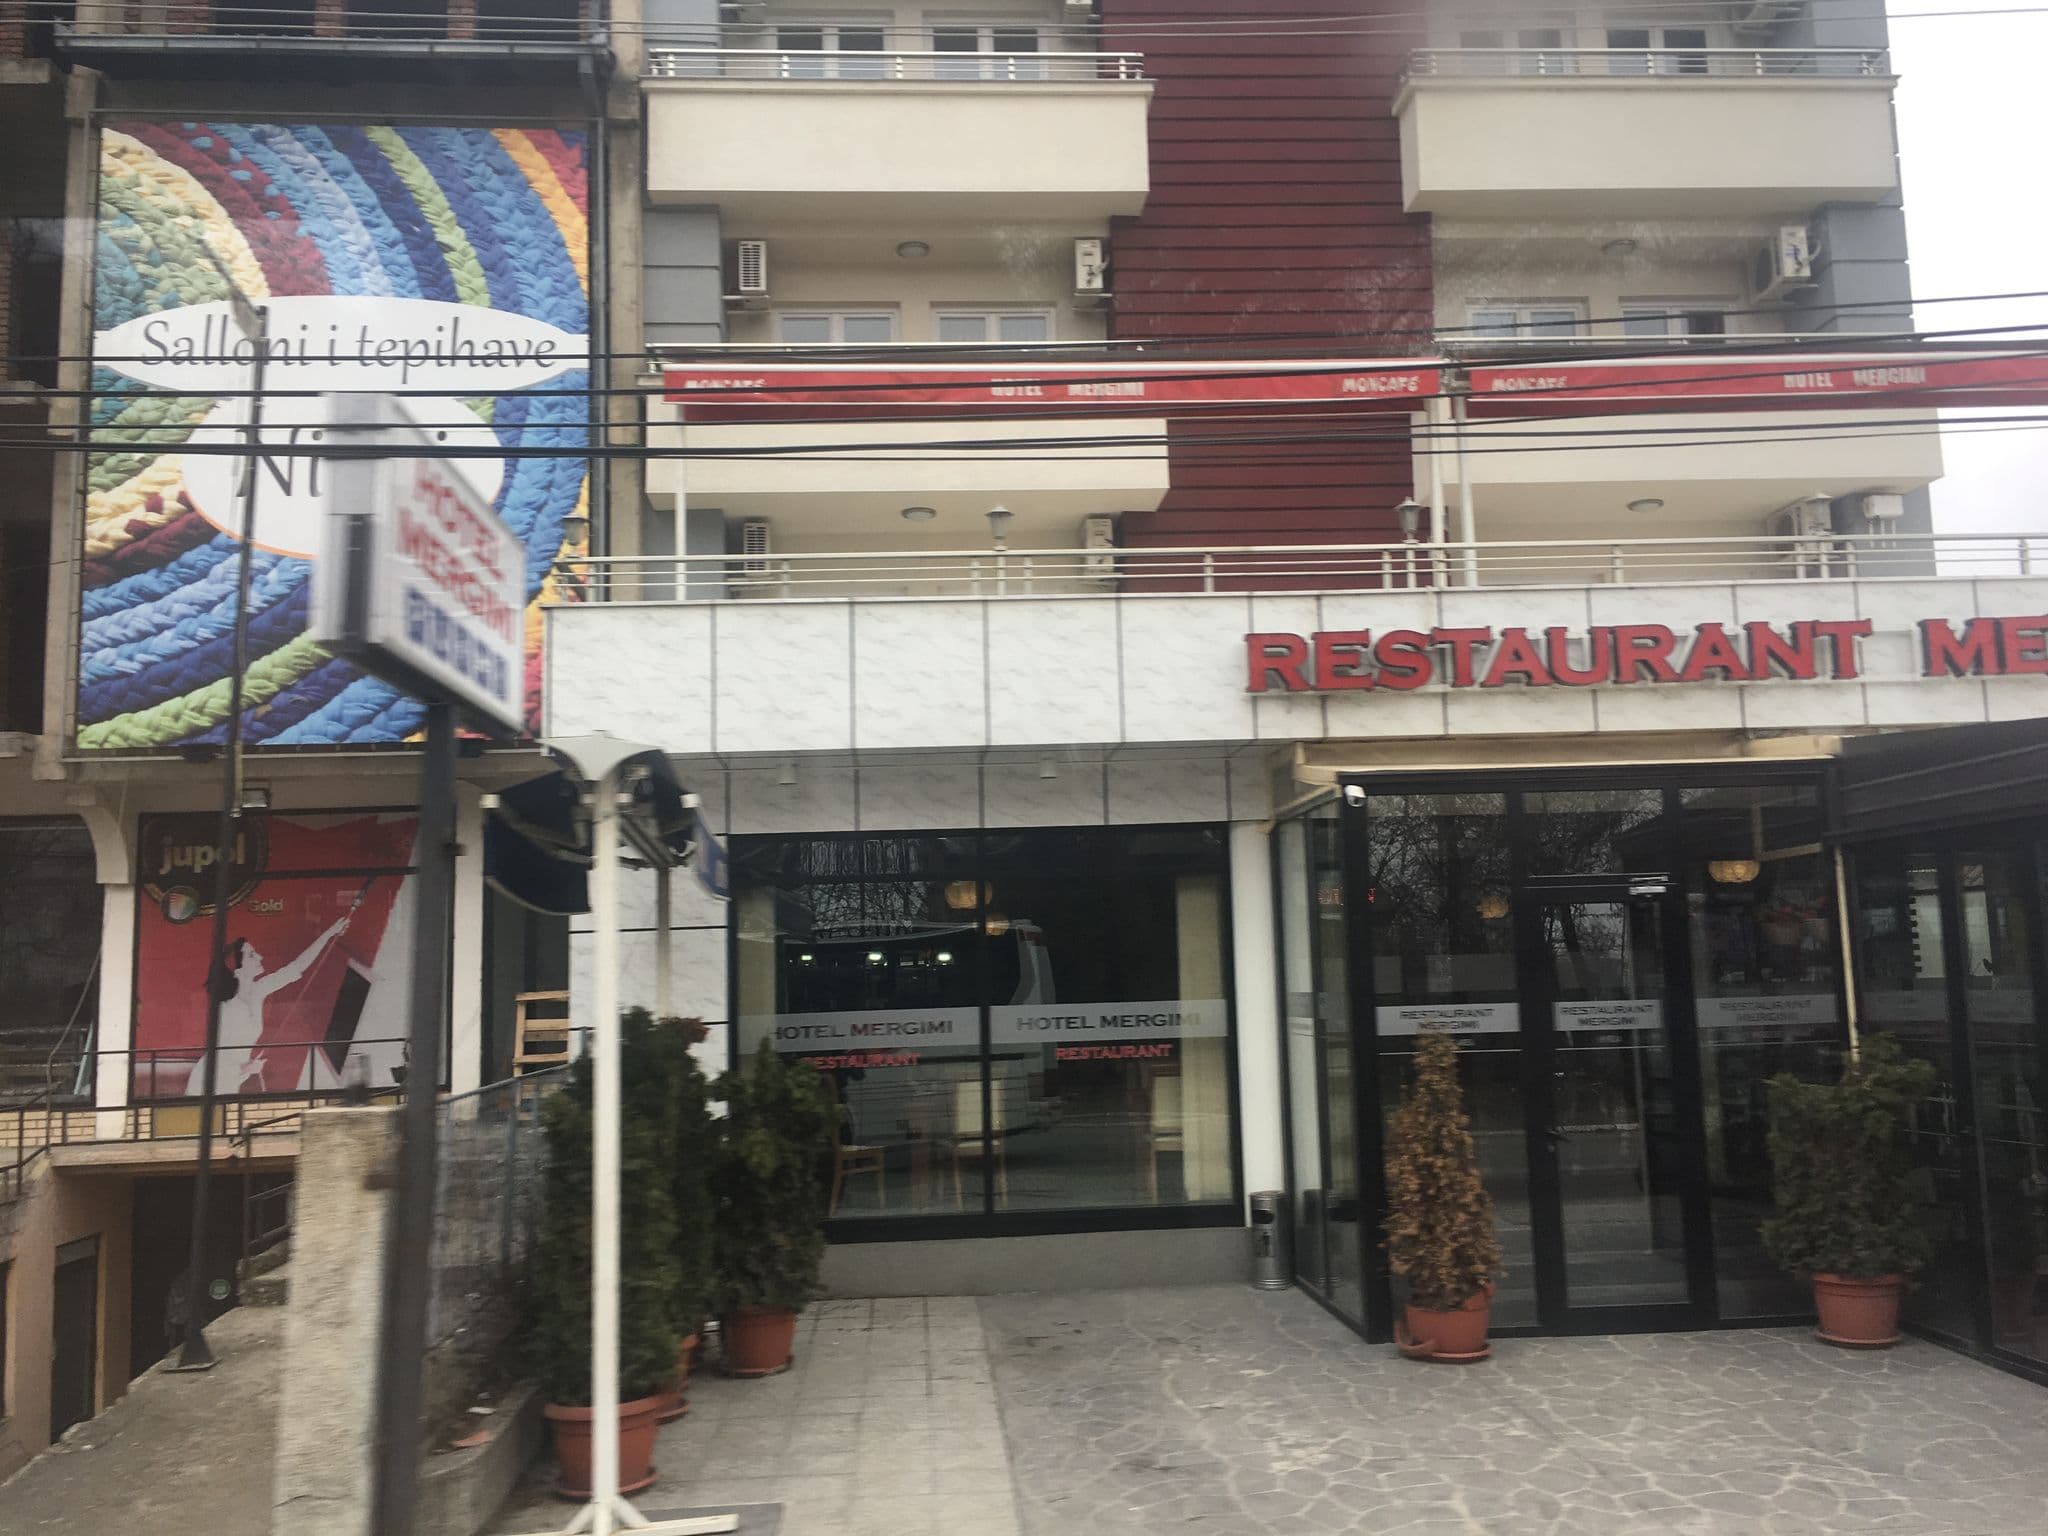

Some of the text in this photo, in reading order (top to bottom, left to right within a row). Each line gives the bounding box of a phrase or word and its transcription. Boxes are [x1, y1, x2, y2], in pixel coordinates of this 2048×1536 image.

[141, 313, 558, 384] Salloni i tepihave
[1783, 367, 1926, 388] HOTEL MERGIMI
[1244, 618, 1874, 693] RESTAURANT
[769, 1020, 953, 1040] HOTEL MERGIMI
[1017, 1013, 1201, 1031] HOTEL MERGIMI
[1055, 1044, 1173, 1061] RESTAURANT
